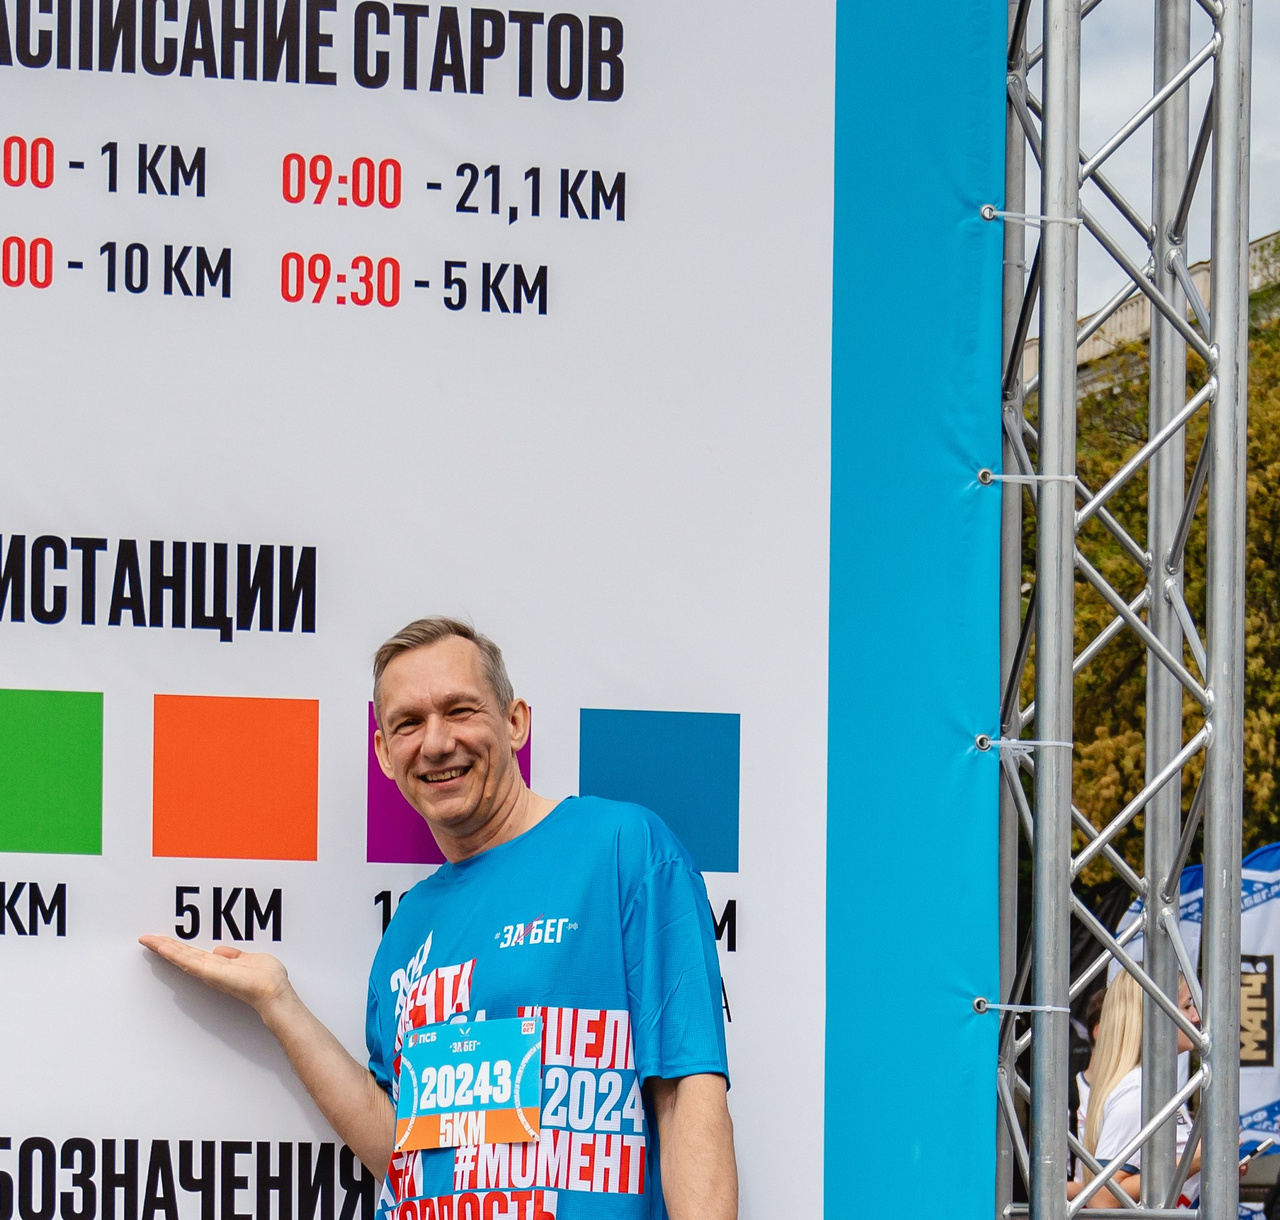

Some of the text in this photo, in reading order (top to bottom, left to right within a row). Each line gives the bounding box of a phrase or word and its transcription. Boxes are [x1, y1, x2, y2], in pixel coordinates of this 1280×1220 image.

[352, 2, 624, 102] СТАРТОВ
[101, 142, 117, 192] 1
[138, 144, 205, 197] КМ
[283, 153, 401, 208] 09:00
[456, 163, 540, 224] 21,1
[560, 169, 625, 221] КМ
[100, 242, 148, 293] 10
[164, 245, 231, 298] КМ
[281, 252, 400, 307] 09:30
[444, 261, 466, 311] 5
[482, 263, 547, 315] КМ
[175, 886, 282, 941] 5 КМ
[420, 1060, 512, 1110] 20243
[542, 1067, 645, 1132] 2024
[453, 1128, 646, 1194] #МОМЕНТ
